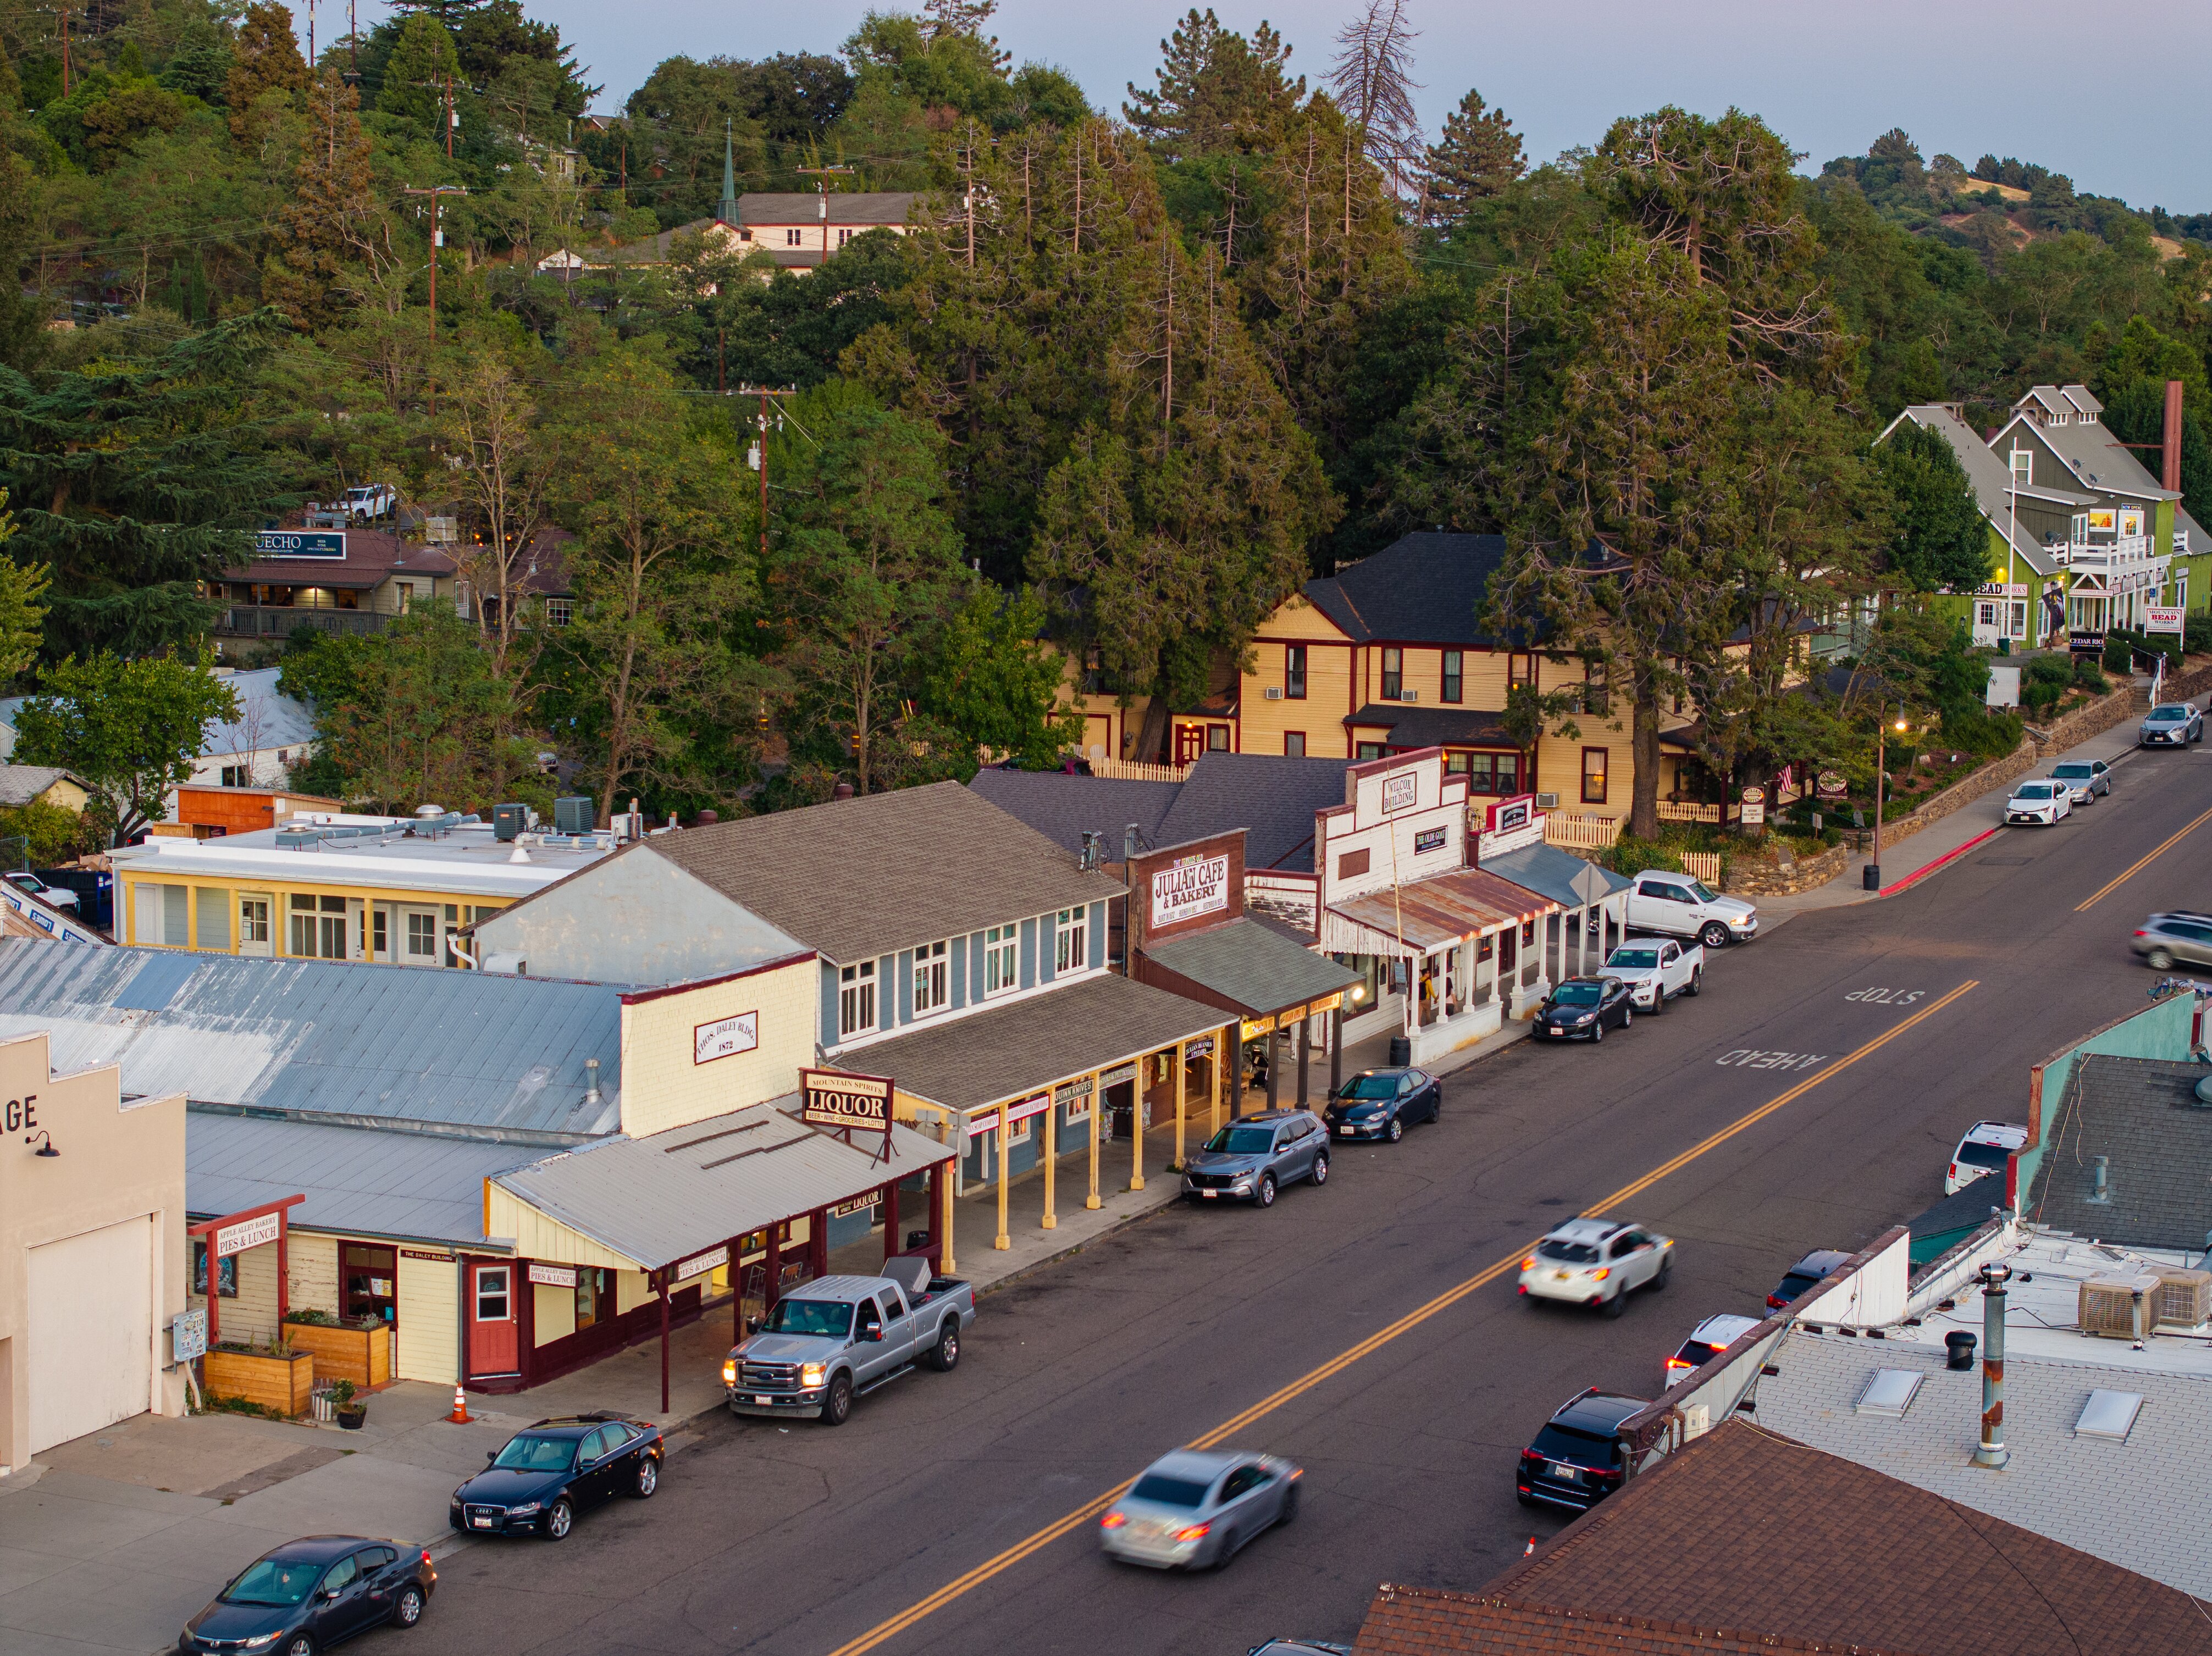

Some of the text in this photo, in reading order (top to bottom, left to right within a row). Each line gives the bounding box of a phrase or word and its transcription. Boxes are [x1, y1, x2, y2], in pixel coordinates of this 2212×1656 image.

[248, 536, 301, 549] UECHO
[1417, 829, 1446, 845] THE OLDE GOAT
[1181, 855, 1196, 866] FAMOUS
[1155, 860, 1224, 899] JULIAN CAFE
[1163, 883, 1217, 910] & BAKERY
[1844, 987, 1926, 1005] STOP
[696, 1021, 755, 1055] THOS. DALEY BLDG.
[718, 1040, 733, 1052] 1872
[1186, 1044, 1198, 1055] JULIAN
[1715, 1049, 1828, 1071] AHEAD
[812, 1078, 883, 1094] MOUNTAIN SPIRITS
[1099, 1075, 1111, 1087] ISTOLS
[1115, 1068, 1136, 1079] PETTICOATS
[1055, 1087, 1071, 1101] QUINN
[1072, 1081, 1092, 1094] KNIVES
[808, 1090, 884, 1117] LIQUOR
[0, 1094, 37, 1135] GE
[808, 1111, 821, 1120] BEER
[838, 1116, 865, 1125] GROCERIES
[982, 1116, 998, 1128] COMPANY
[853, 1191, 879, 1209] LIQUOR
[219, 1216, 276, 1239] APPLE ALLEY BAKERY
[220, 1226, 276, 1253] PIES & LUNCH
[678, 1266, 694, 1278] PIES
[702, 1254, 726, 1269] LUNCH
[531, 1272, 546, 1280] PIES
[554, 1275, 575, 1284] LUNCH
